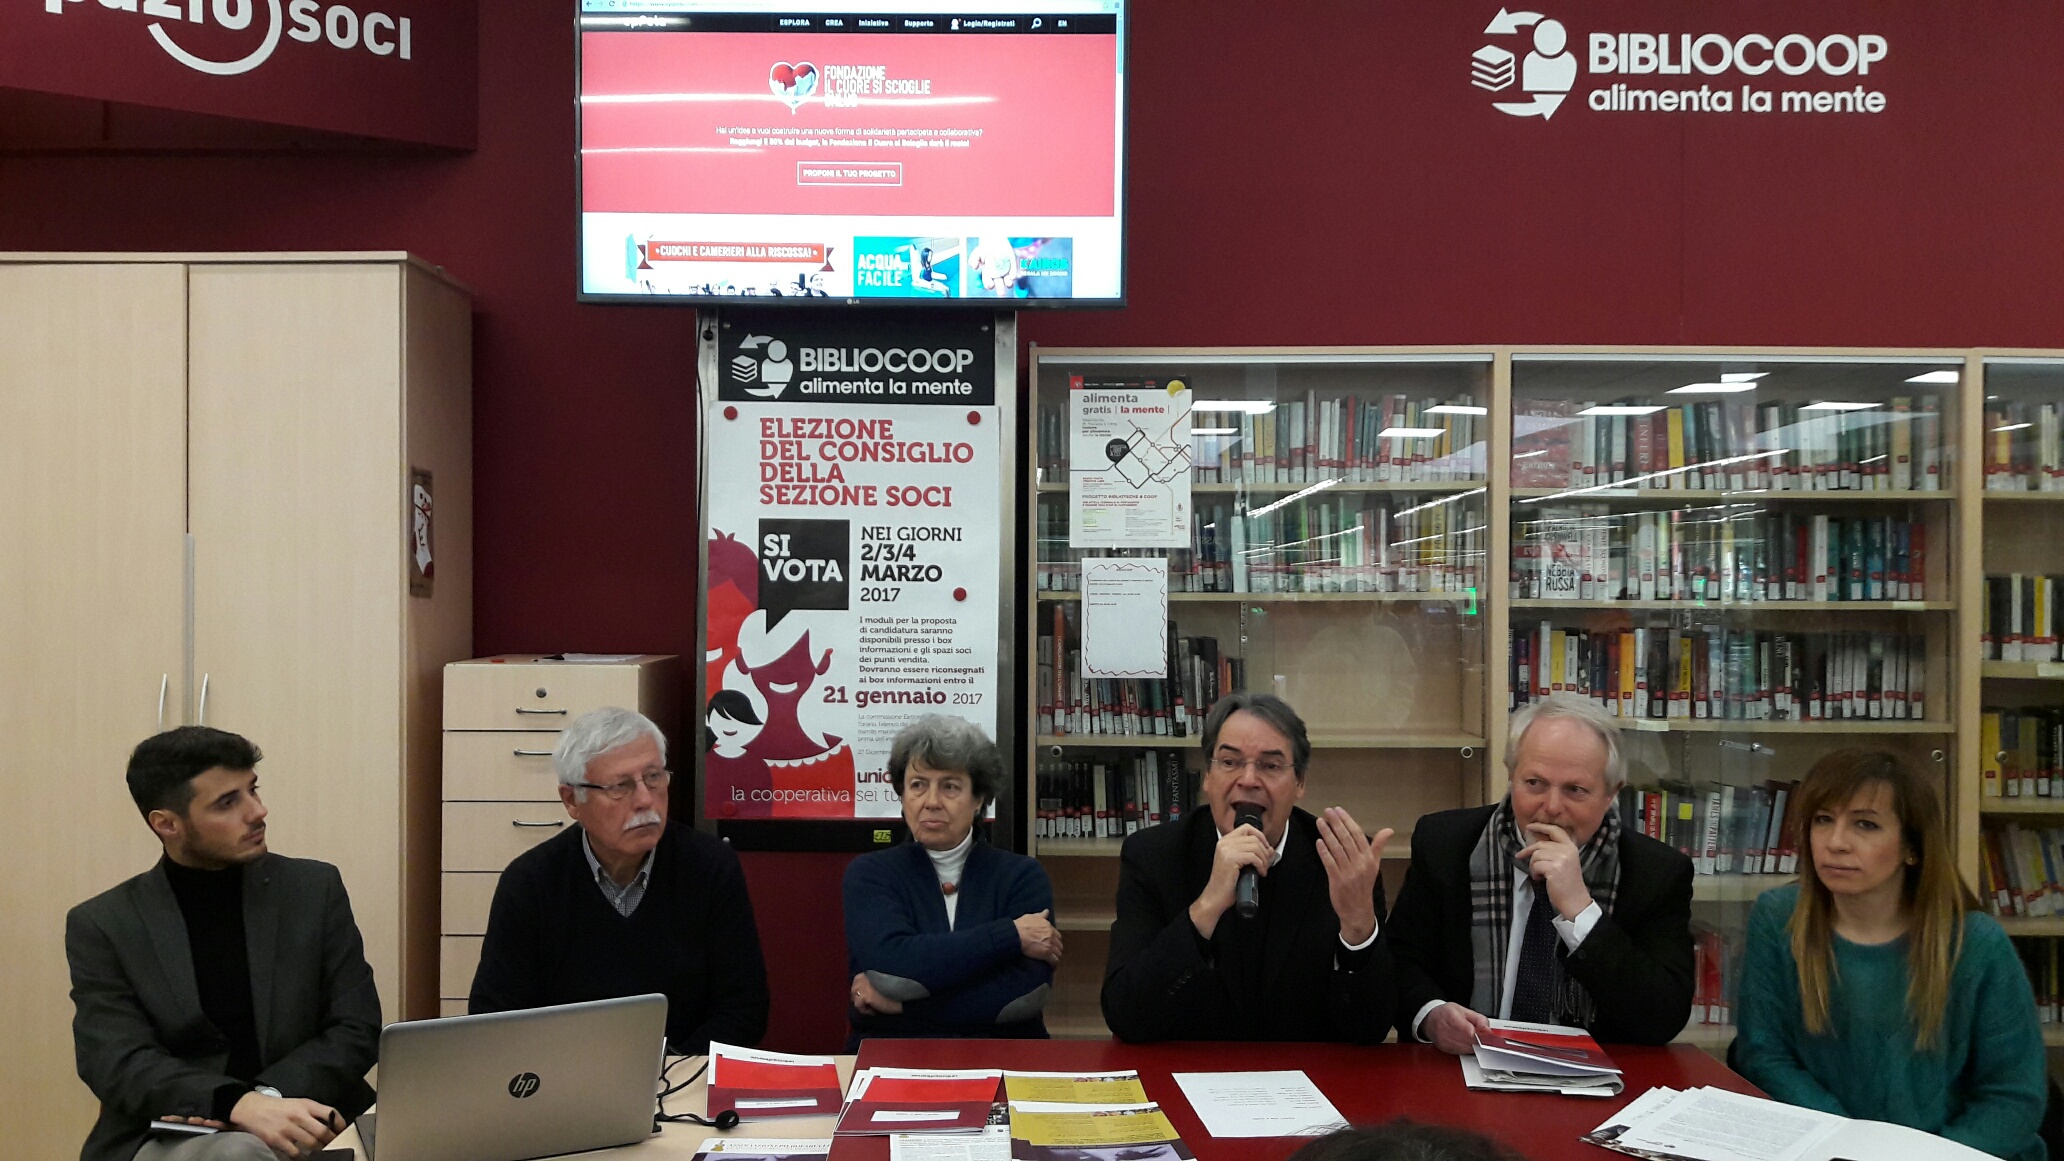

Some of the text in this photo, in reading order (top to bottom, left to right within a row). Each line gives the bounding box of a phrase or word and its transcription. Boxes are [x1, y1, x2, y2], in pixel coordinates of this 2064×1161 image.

[287, 0, 411, 60] SOCI
[779, 18, 810, 27] ESPLORA
[825, 19, 844, 27] CREA
[904, 19, 934, 28] Supporto
[1588, 33, 1888, 76] BIBLIOCOOP
[824, 65, 886, 80] FONDAZIONE
[824, 80, 930, 95] IL CUORE SI SCIOGLIE
[1588, 84, 1887, 114] alimenta la mente
[716, 127, 727, 135] Hai
[757, 127, 771, 135] vuoi
[858, 170, 896, 178] PROGETTO
[660, 246, 691, 256] CUOCHI
[693, 246, 699, 257] E
[700, 246, 745, 257] CAMERIERI
[746, 247, 766, 258] ALLA
[858, 253, 903, 271] ACQUA
[858, 271, 902, 287] FACILE
[800, 348, 974, 373] BIBLIOCOOP
[800, 378, 973, 395] alimenta la mente
[1082, 393, 1138, 403] alimenta
[1082, 405, 1165, 415] gratis la mente
[760, 418, 893, 440] ELEZIONE
[760, 440, 974, 463] DEL CONSIGLIO
[760, 462, 845, 484] DELLA
[760, 484, 952, 507] SEZIONE SOCI
[860, 526, 962, 542] NEI GIORNI
[763, 534, 790, 557] SI
[861, 544, 916, 562] 2/3/4
[763, 559, 843, 582] VOTA
[860, 565, 942, 582] MARZO
[1546, 577, 1574, 591] RUSSA
[860, 588, 900, 602] 2017
[859, 616, 863, 624] I
[865, 616, 894, 624] moduli
[896, 618, 909, 626] per
[921, 618, 957, 626] proposta
[859, 626, 868, 634] di
[869, 626, 918, 634] candidatura
[859, 636, 902, 645] disponibili
[920, 646, 930, 655] gli
[932, 647, 953, 655] spazi
[874, 656, 895, 664] punti
[859, 665, 900, 673] Dovranno
[931, 666, 985, 675] riconsegnati
[886, 676, 941, 684] informazioni
[823, 686, 983, 708] 21 gennaio 2017
[857, 768, 891, 783] unic
[731, 785, 745, 801] la
[751, 786, 850, 804] cooperativa
[857, 787, 878, 802] sei
[512, 1073, 537, 1098] hp
